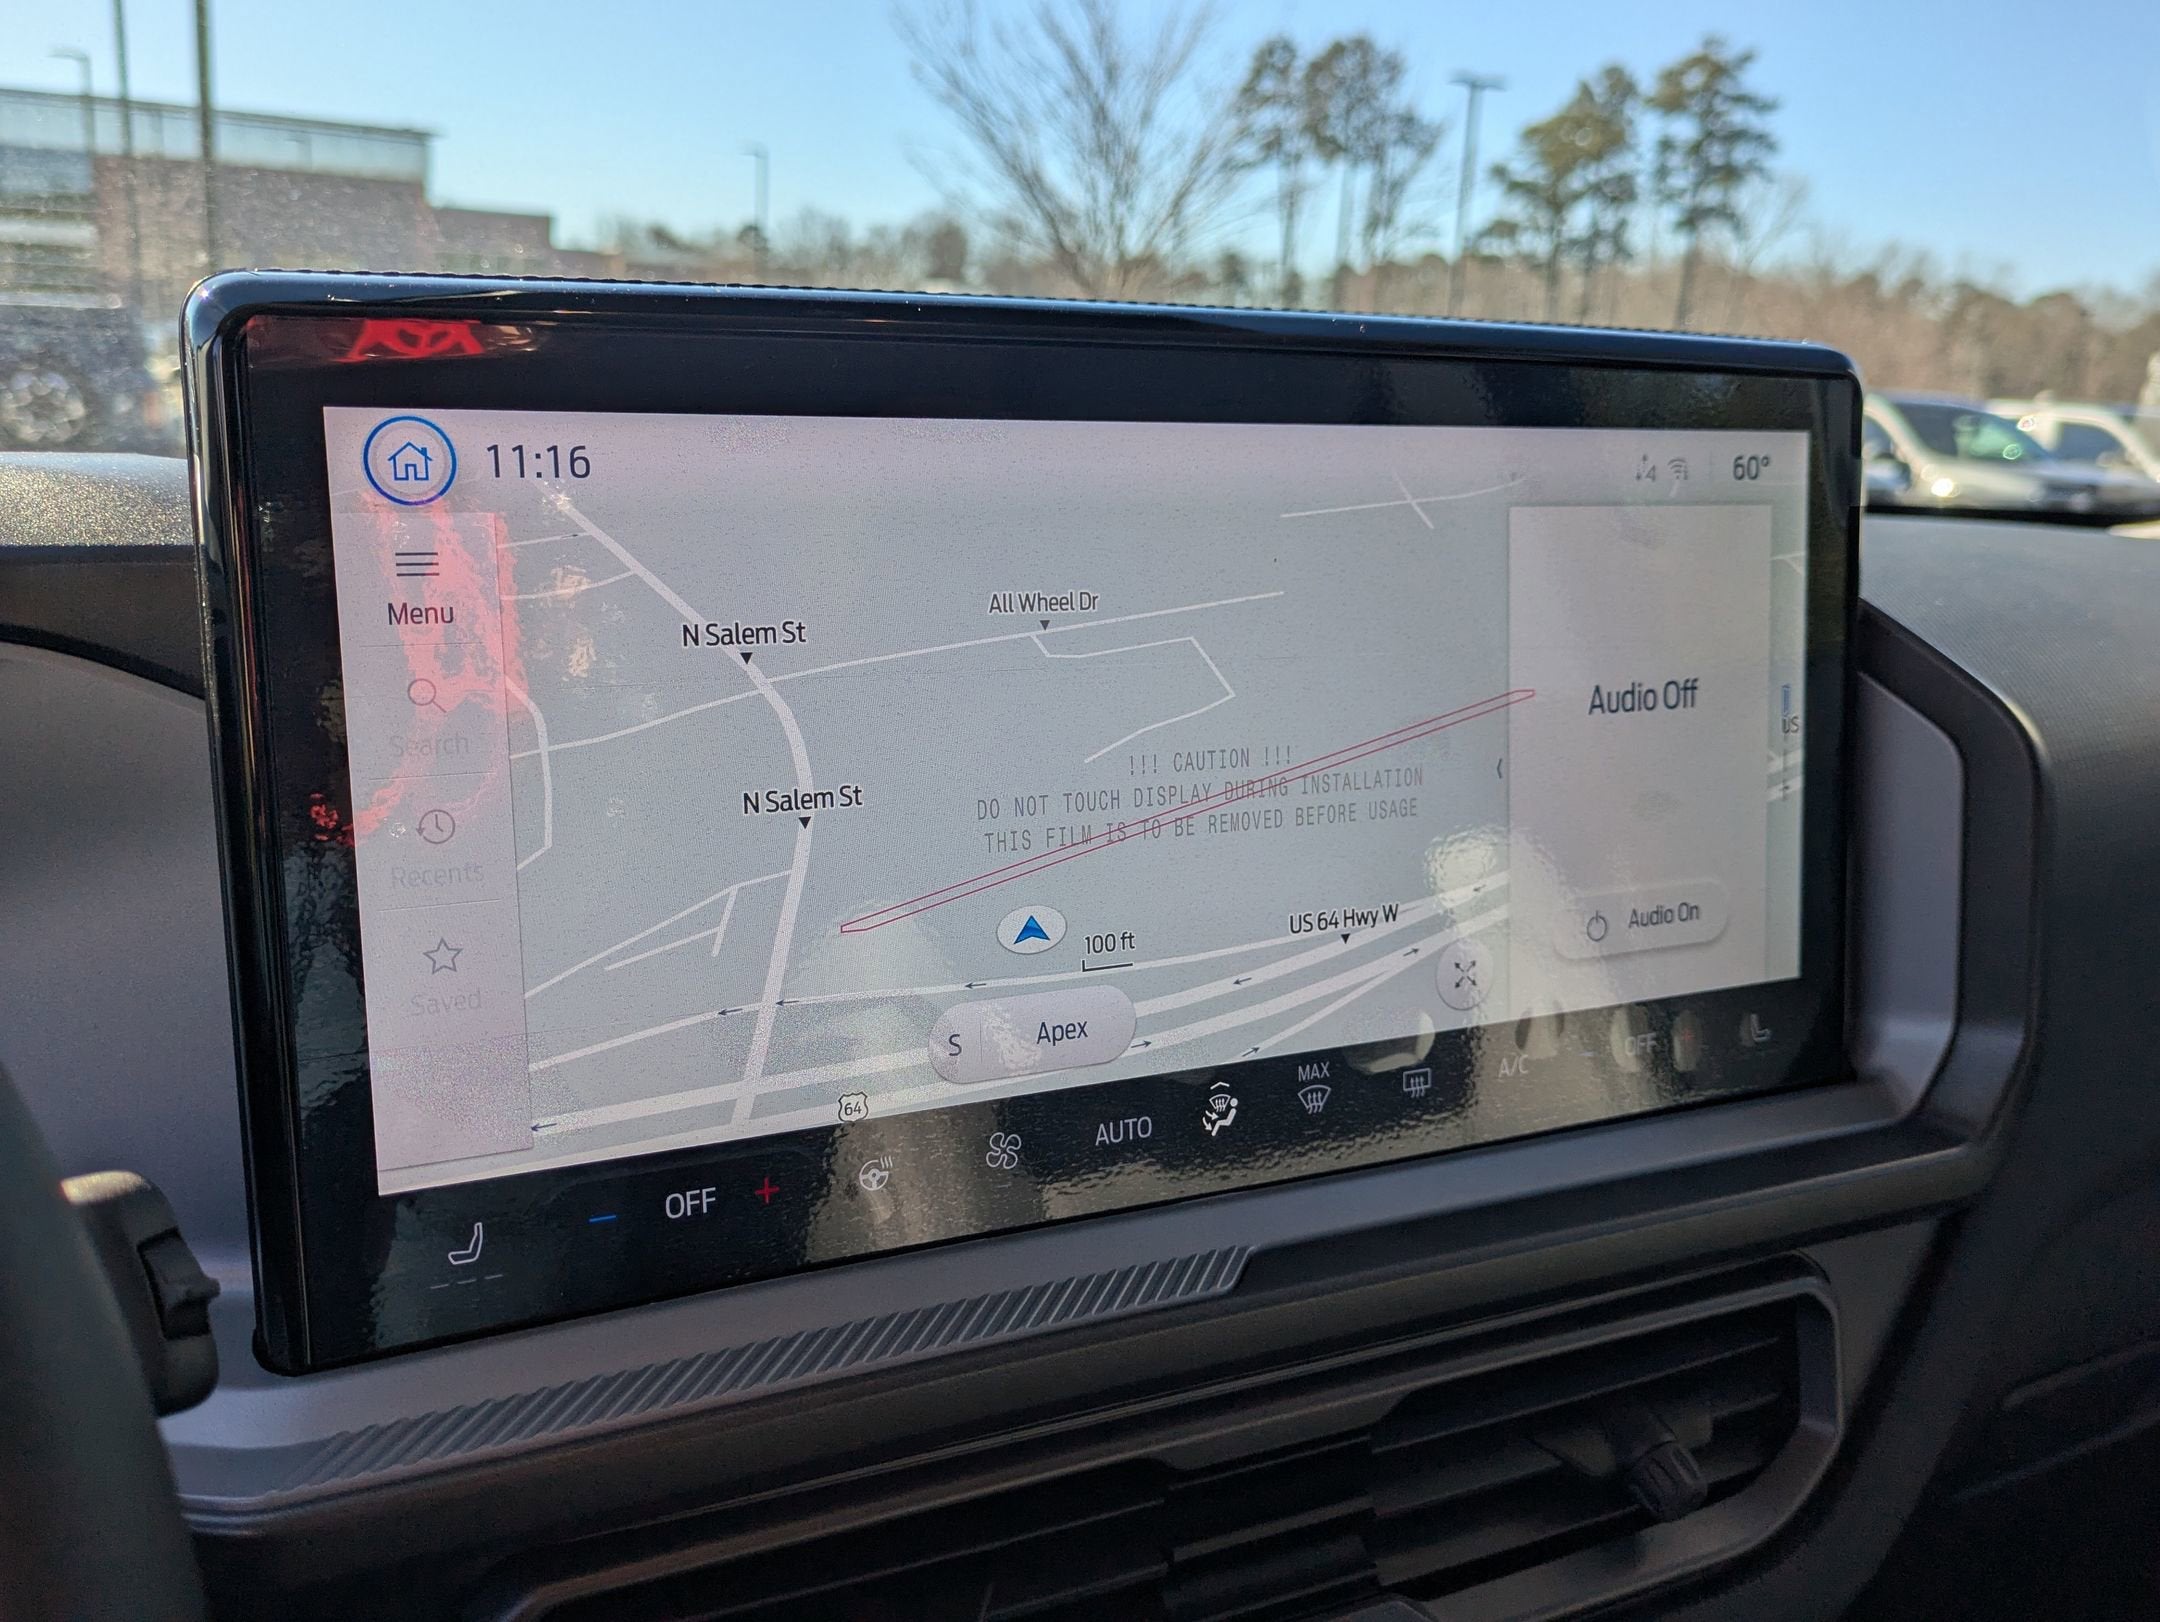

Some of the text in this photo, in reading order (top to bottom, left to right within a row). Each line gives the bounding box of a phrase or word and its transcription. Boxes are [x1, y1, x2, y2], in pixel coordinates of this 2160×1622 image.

[487, 443, 591, 480] 11:16
[388, 602, 454, 627] Menu
[989, 591, 1099, 613] All Wheel Dr
[683, 621, 807, 647] N Salem St
[1589, 678, 1698, 715] Audio Off
[389, 731, 469, 757] Search
[1173, 748, 1251, 773] CAUTION
[743, 785, 863, 815] N Salem St
[977, 767, 1423, 821] DO NOT TOUCH DISPLAY DURING INSTALLATION
[984, 797, 1418, 854] THIS FILM IS TO BE REMOVED BEFORE USAGE
[392, 862, 484, 889] Recents
[1289, 904, 1399, 935] US 64 Hwy W
[1629, 902, 1699, 929] Audio On
[1084, 933, 1135, 955] 100 ft
[410, 990, 482, 1017] Saved
[948, 1034, 963, 1057] S
[1036, 1020, 1089, 1047] Apex
[1625, 1033, 1657, 1057] OFF
[1298, 1062, 1330, 1083] MAX
[1499, 1055, 1529, 1078] A/C
[843, 1101, 862, 1118] 64
[1095, 1116, 1153, 1146] AUTO
[665, 1187, 716, 1219] OFF
